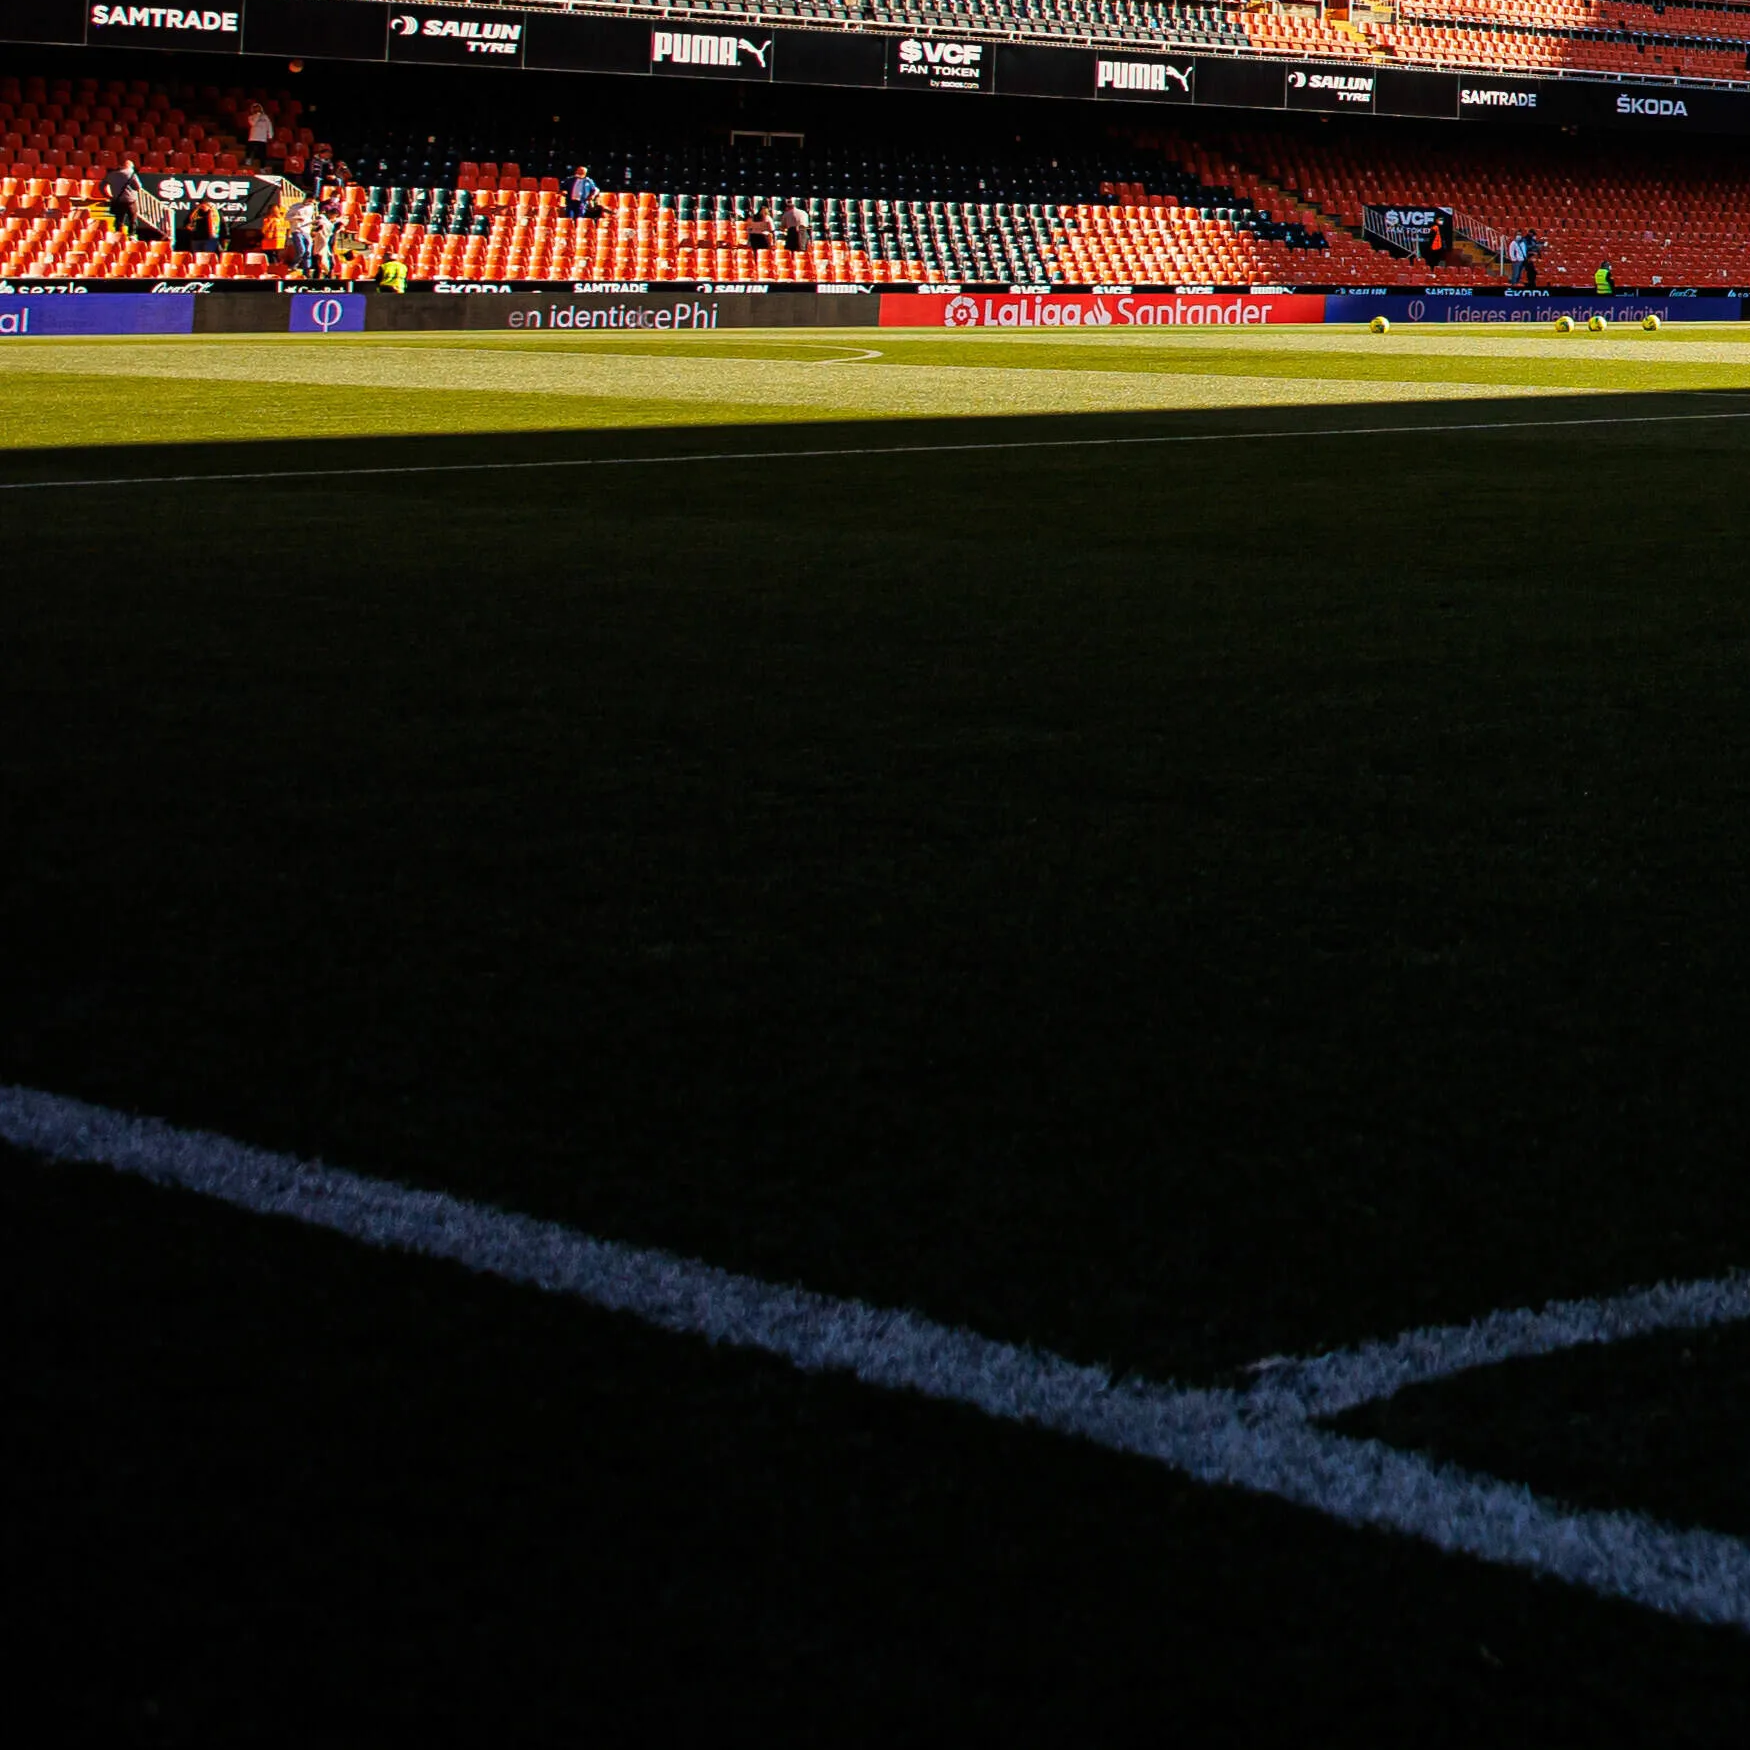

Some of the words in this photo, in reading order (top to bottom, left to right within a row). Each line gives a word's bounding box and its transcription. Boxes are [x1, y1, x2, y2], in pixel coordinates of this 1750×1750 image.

[91, 4, 239, 32] SAMTRADE
[422, 19, 522, 41] SAILUN
[466, 41, 519, 55] TYRE
[653, 32, 742, 67] PUMA
[898, 38, 983, 66] $VCF
[899, 63, 929, 75] FAN
[934, 65, 980, 79] TOKEN
[1097, 61, 1170, 92] PUMA
[1308, 73, 1374, 91] SAILUN
[1337, 91, 1372, 103] TYRE
[1461, 89, 1537, 108] SAMTRADE
[1616, 93, 1688, 117] ŠKODA
[158, 176, 250, 201] $VCF
[1385, 210, 1435, 226] $VCF
[573, 283, 649, 293] SAMTRADE
[1424, 287, 1474, 297] SAMTRADE
[507, 309, 542, 328] en
[983, 296, 1083, 326] LaLiga
[1118, 294, 1273, 325] Santander
[1447, 304, 1504, 323] Líderes
[1508, 308, 1530, 323] en
[1531, 305, 1615, 323] identidad
[1619, 305, 1669, 323] digital
